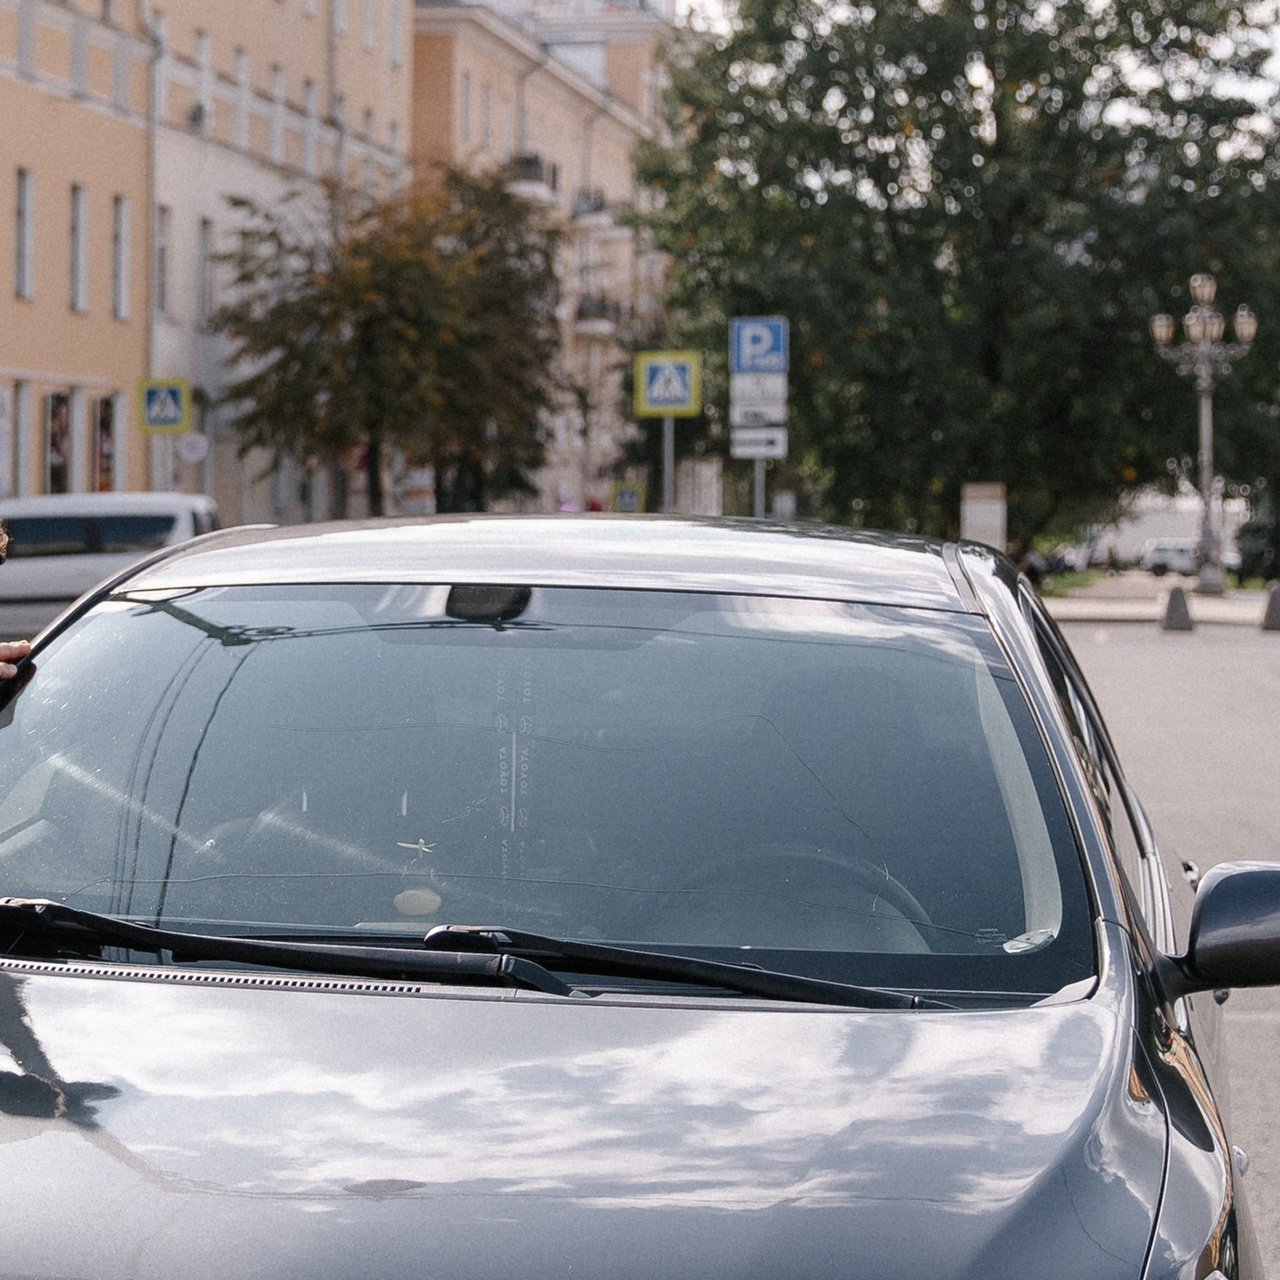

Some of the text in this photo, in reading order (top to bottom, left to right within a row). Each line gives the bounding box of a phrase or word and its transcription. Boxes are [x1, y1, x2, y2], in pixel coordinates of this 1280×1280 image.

[740, 323, 774, 369] P
[500, 746, 509, 793] TOYOTA
[520, 747, 529, 795] TOYOTA
